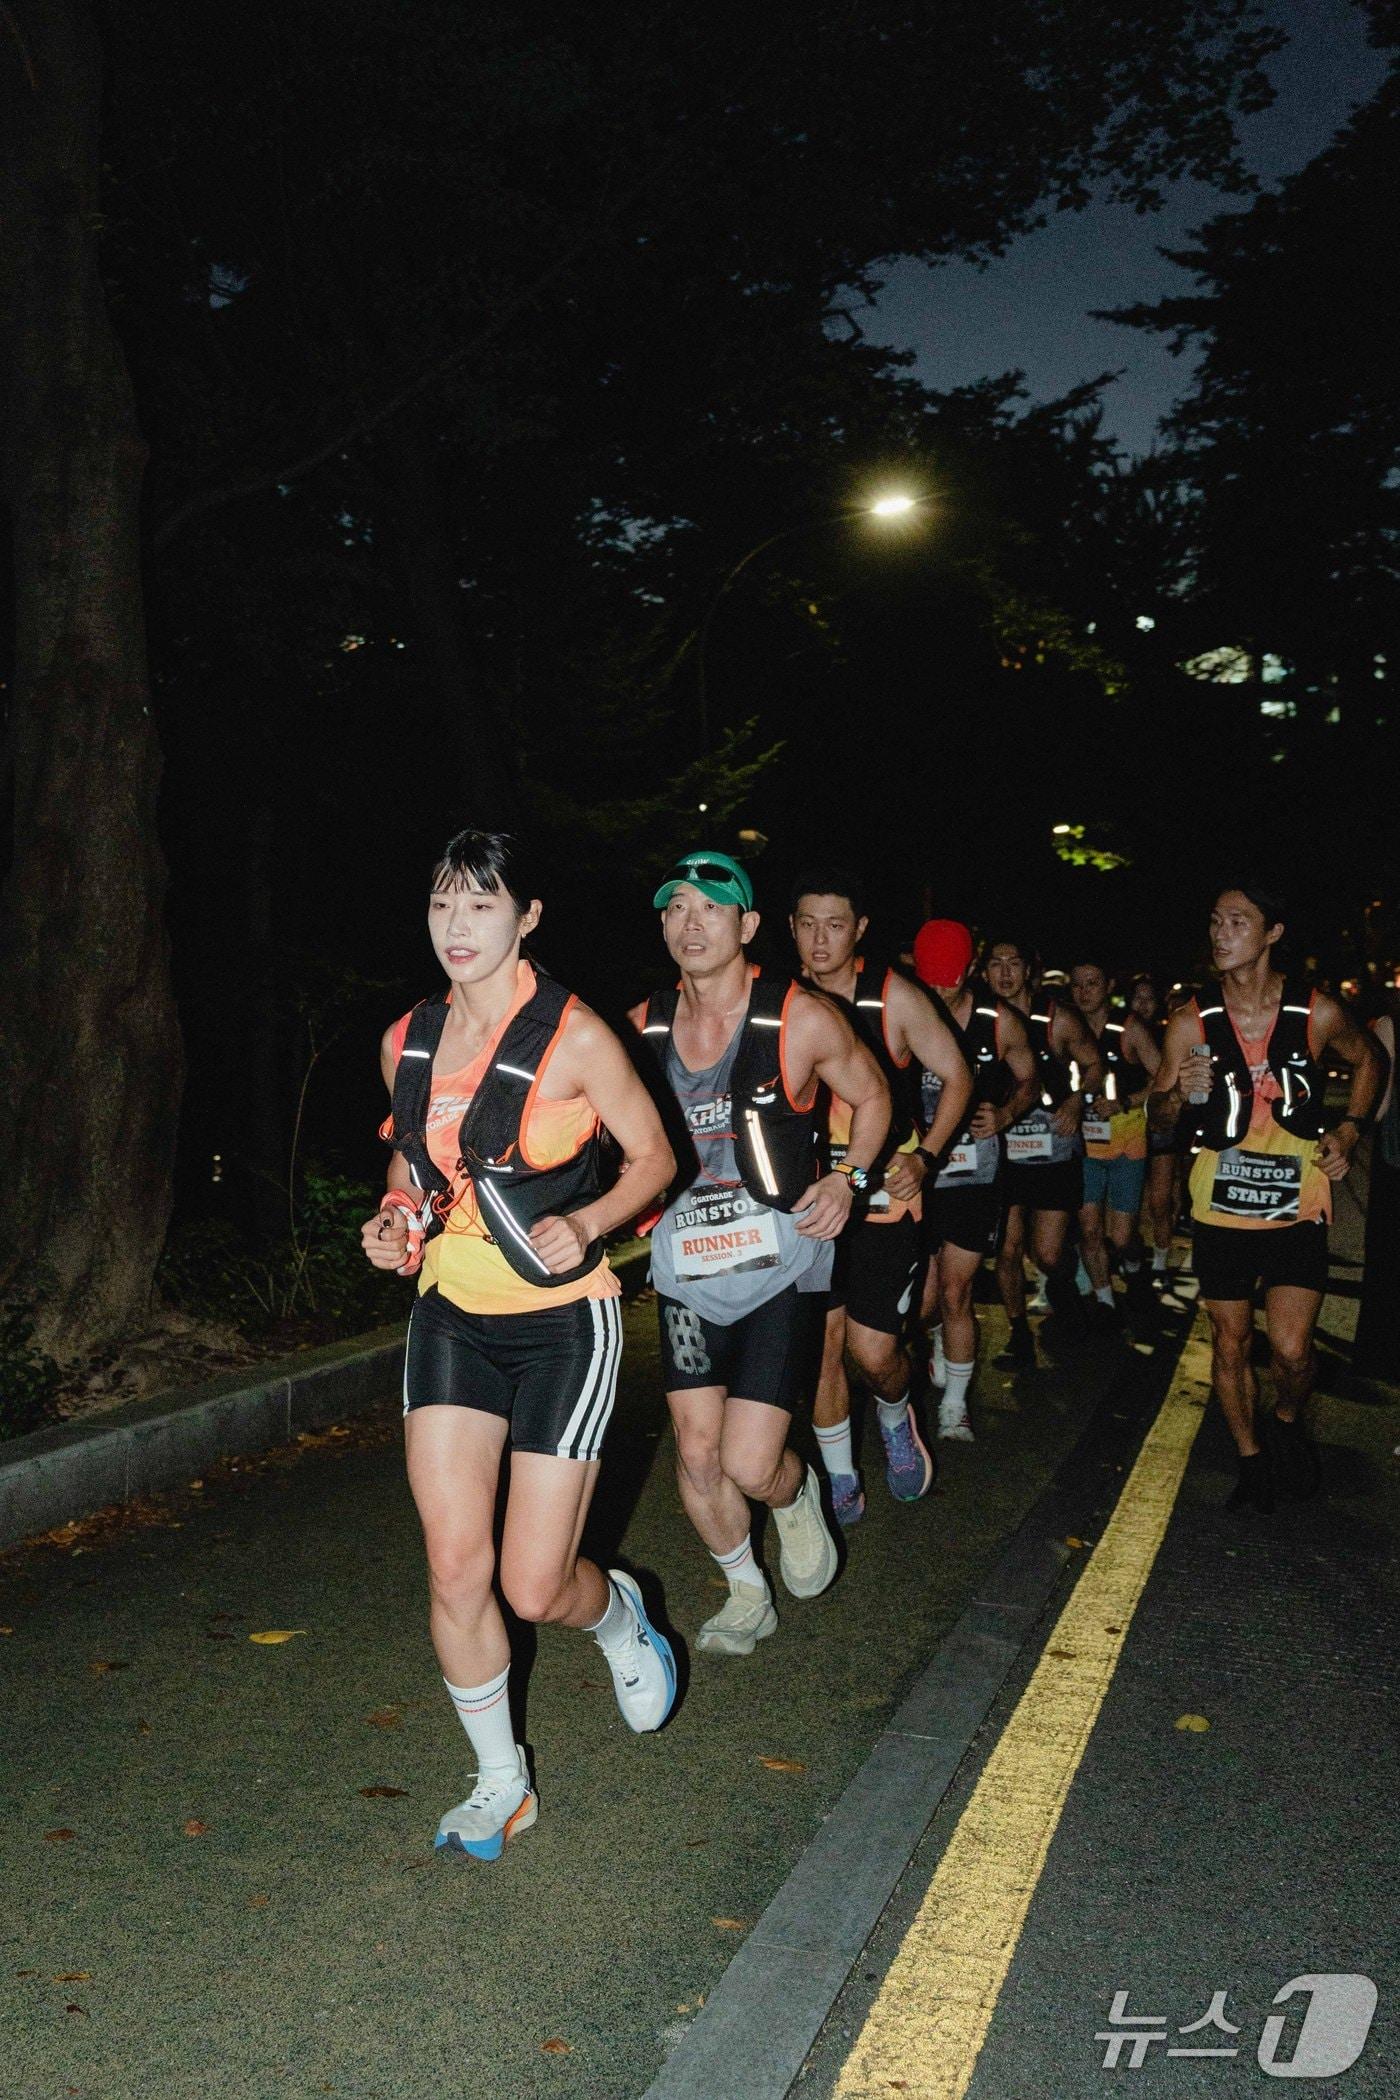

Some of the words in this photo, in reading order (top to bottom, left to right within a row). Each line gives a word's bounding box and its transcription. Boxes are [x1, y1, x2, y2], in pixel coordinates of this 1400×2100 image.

[1222, 1162, 1296, 1180] RUNSTOP
[1227, 1185, 1282, 1205] STAFF
[682, 1228, 762, 1256] RUNNER
